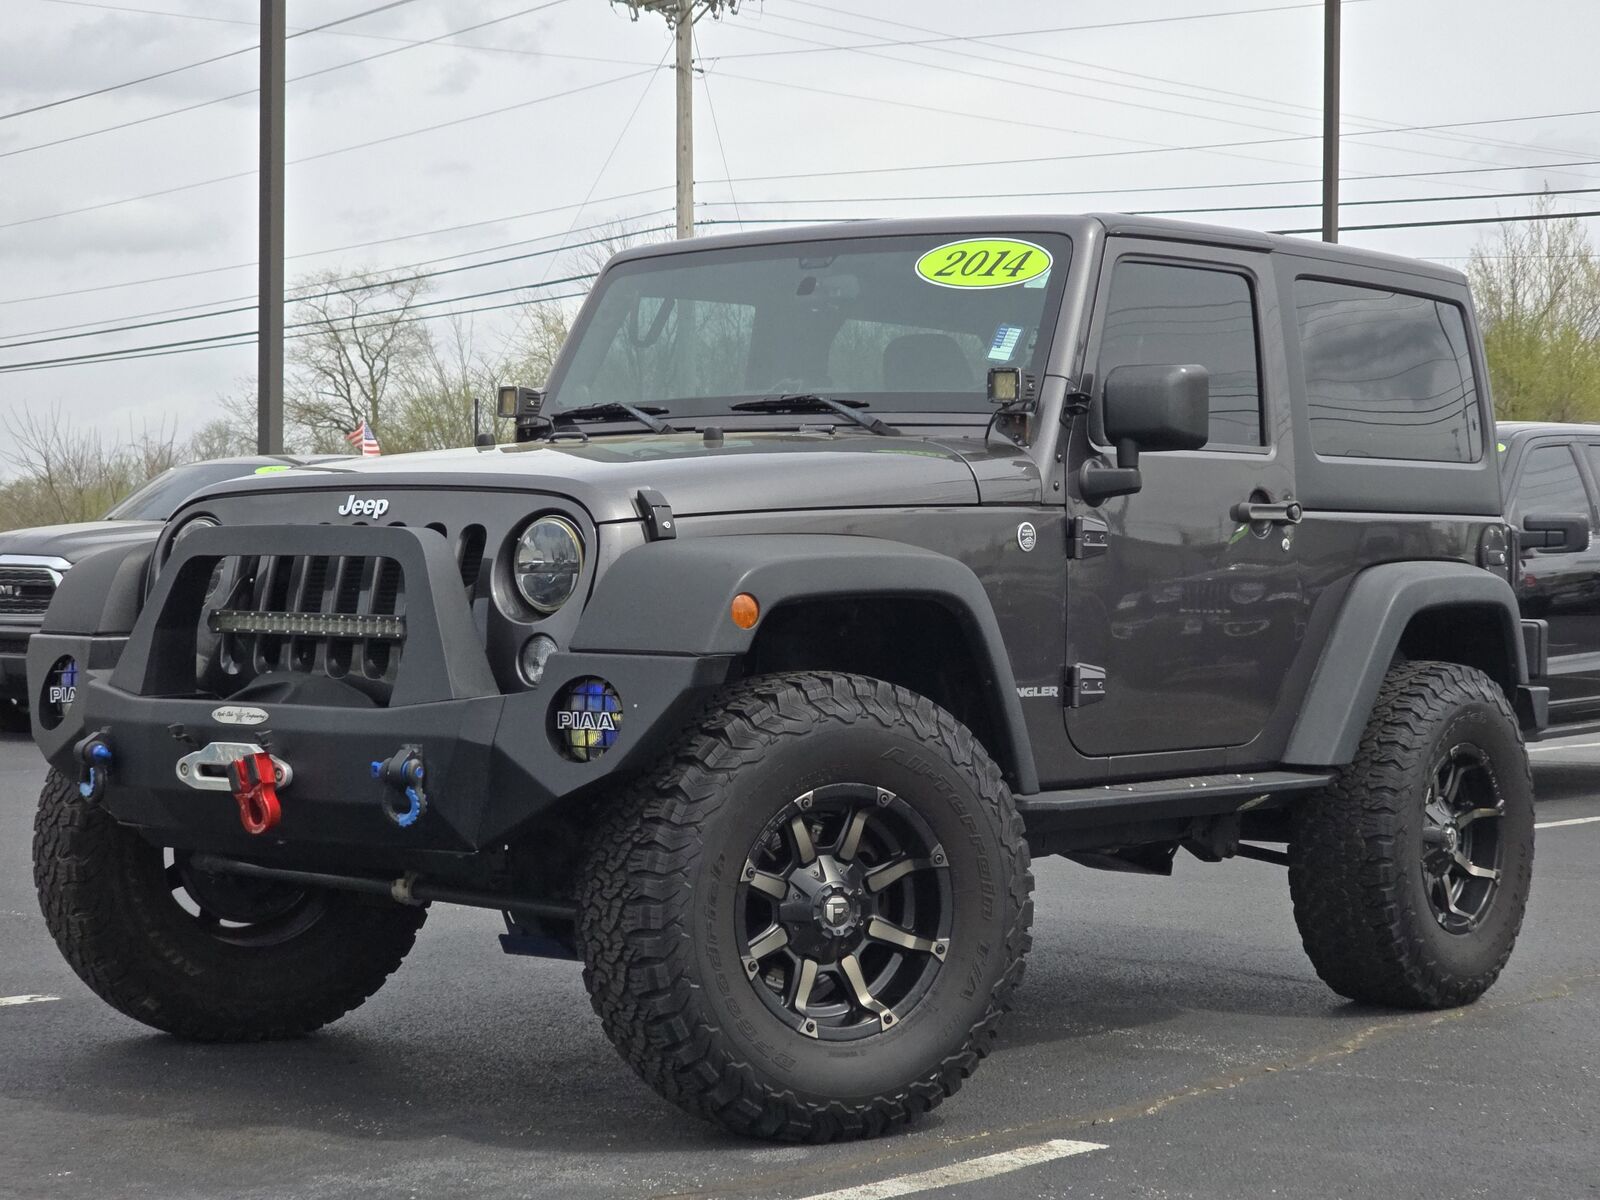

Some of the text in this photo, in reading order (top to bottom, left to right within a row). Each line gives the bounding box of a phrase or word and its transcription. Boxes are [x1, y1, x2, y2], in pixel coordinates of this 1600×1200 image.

[933, 250, 1034, 277] 2014
[338, 494, 389, 520] Jeep
[50, 686, 77, 703] PIA
[1016, 686, 1059, 698] NGLER
[557, 711, 615, 731] PIAA
